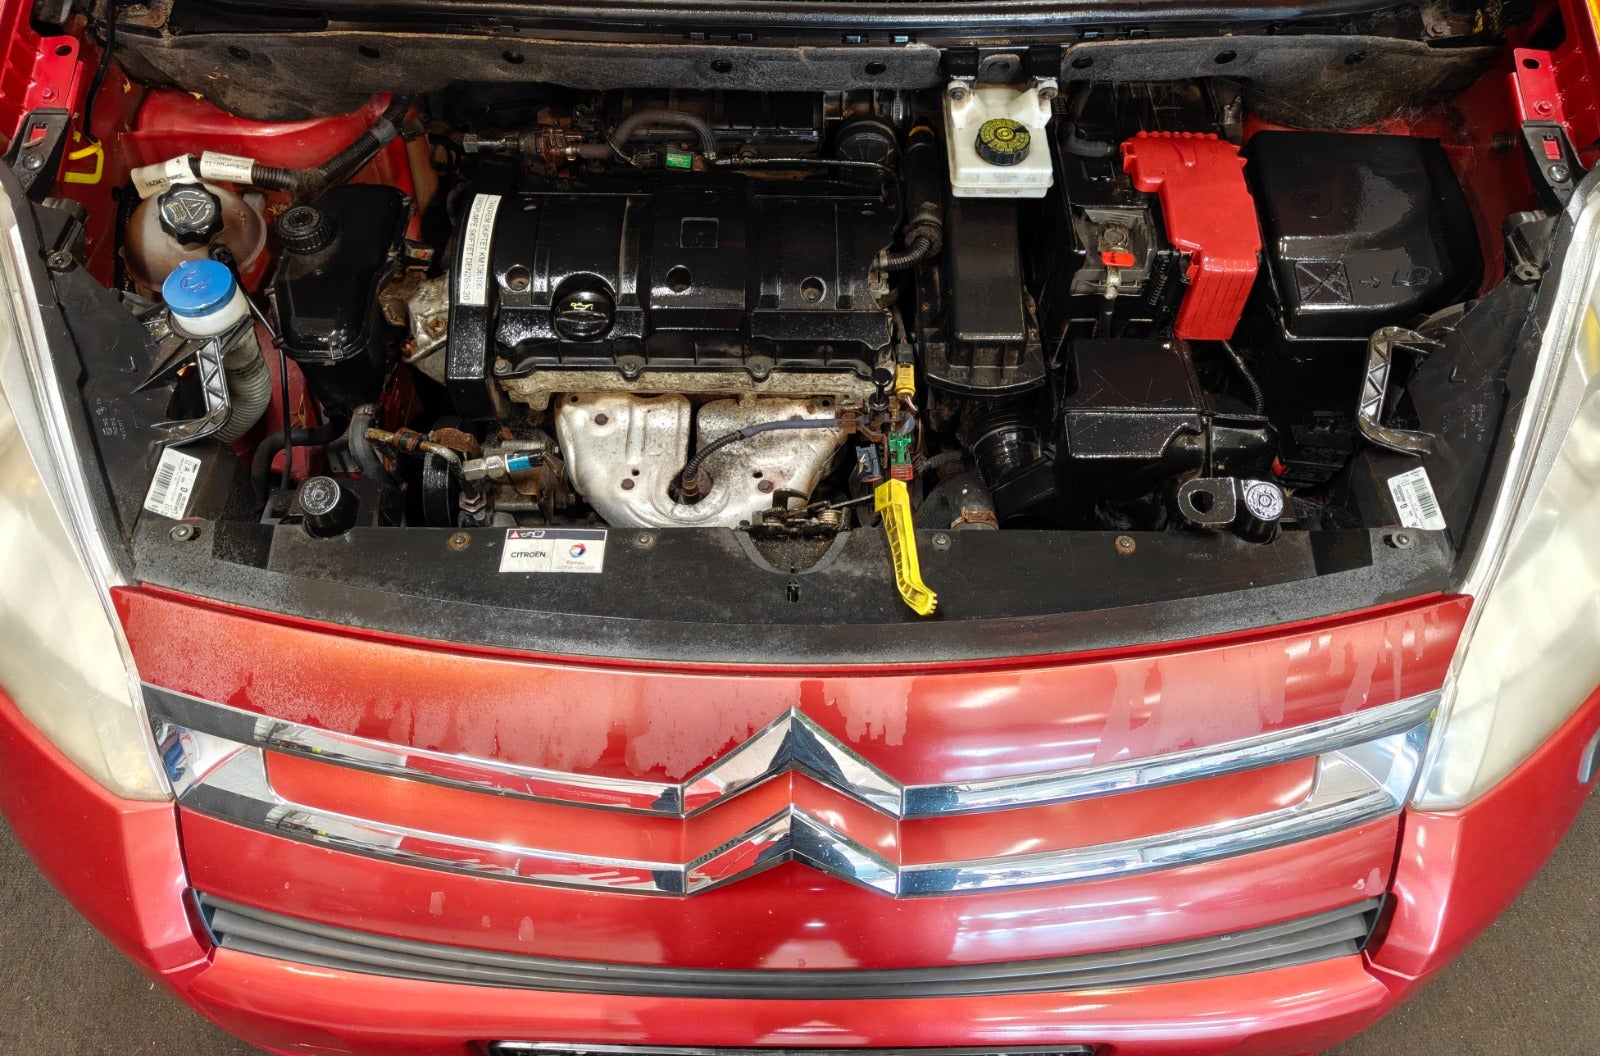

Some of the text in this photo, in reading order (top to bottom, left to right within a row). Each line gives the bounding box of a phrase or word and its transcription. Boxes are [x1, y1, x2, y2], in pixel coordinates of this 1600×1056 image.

[466, 229, 476, 257] SKIFTET
[479, 224, 490, 251] SKIFTET
[510, 550, 546, 558] CITROËN
